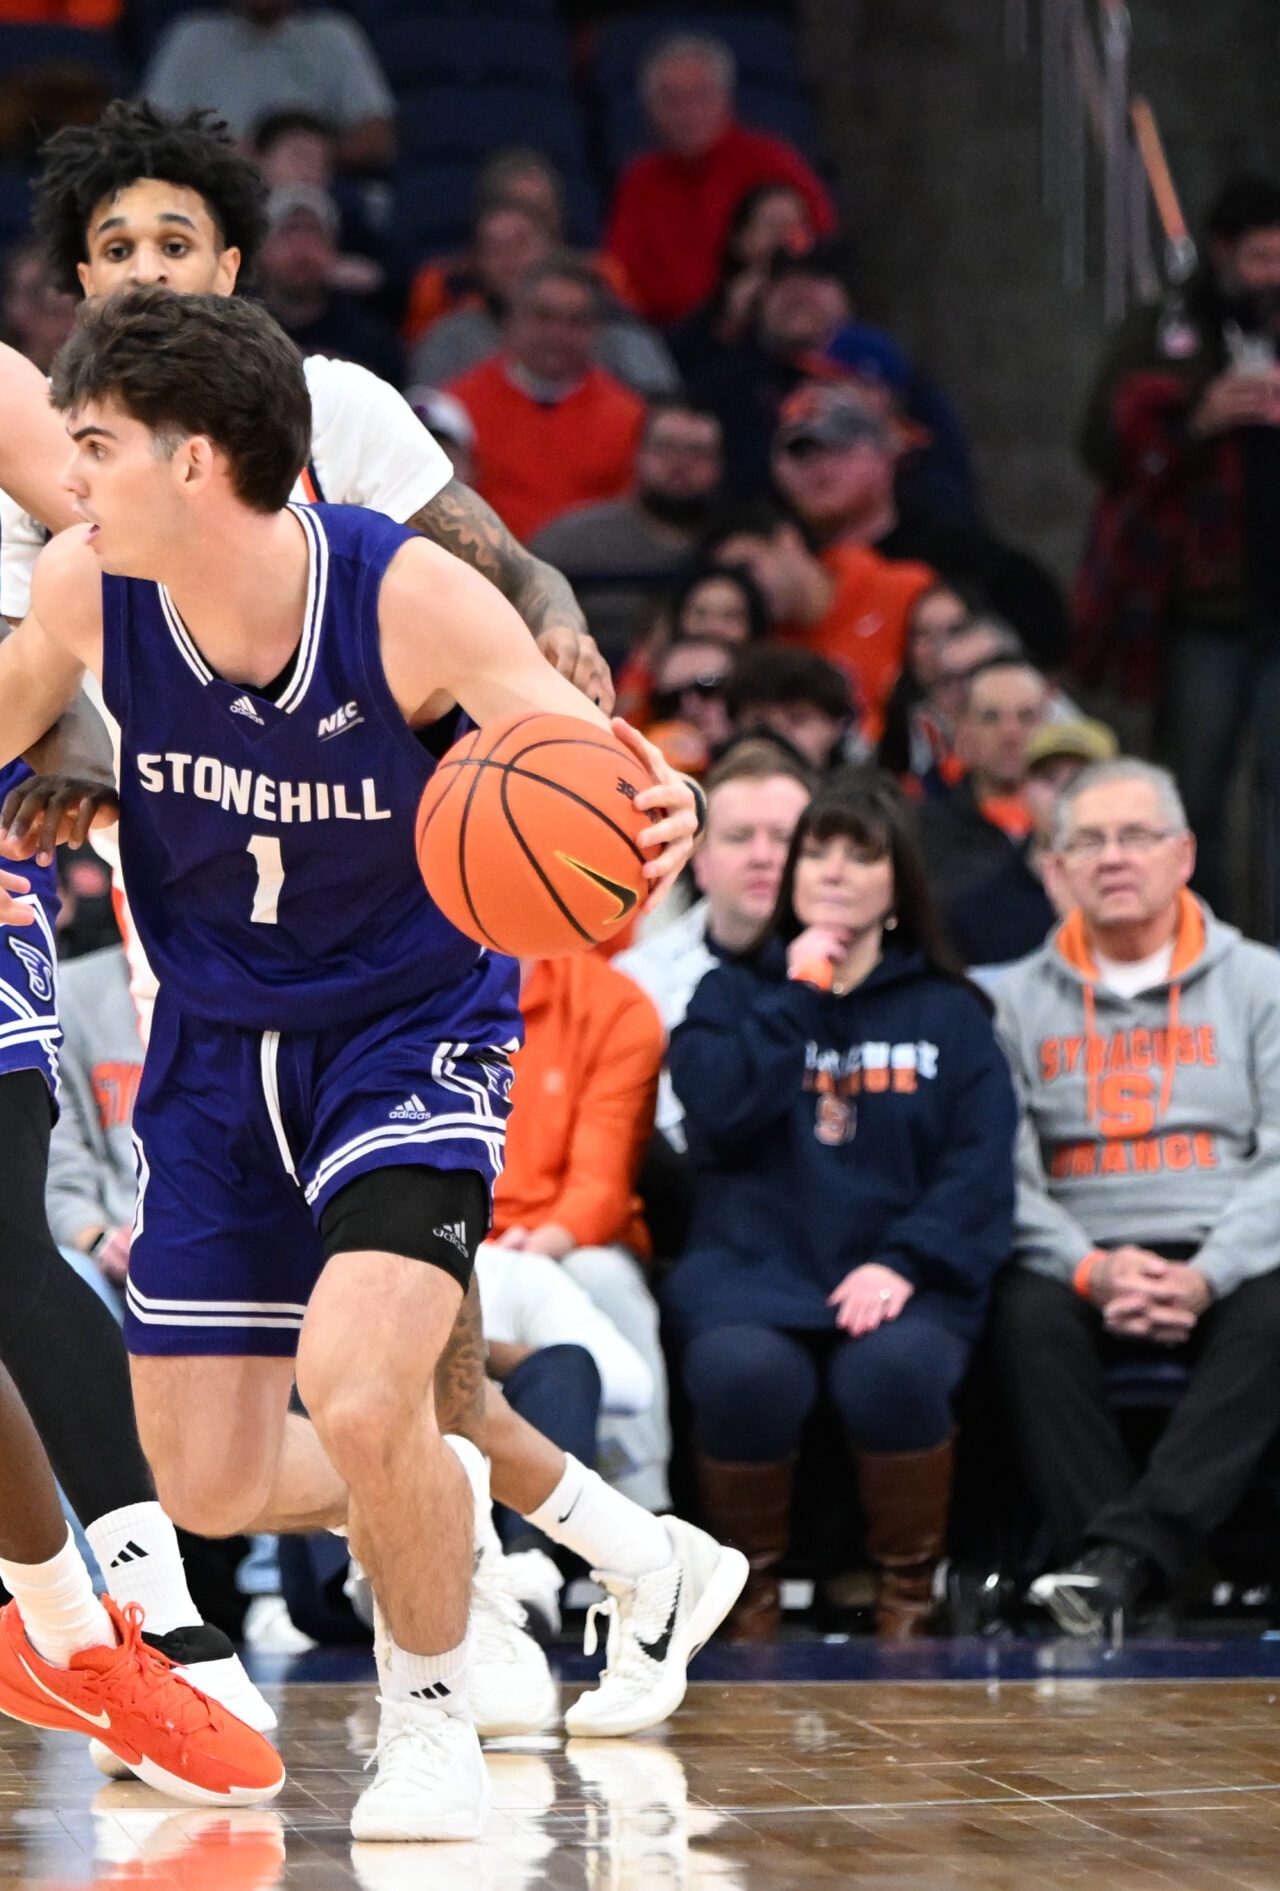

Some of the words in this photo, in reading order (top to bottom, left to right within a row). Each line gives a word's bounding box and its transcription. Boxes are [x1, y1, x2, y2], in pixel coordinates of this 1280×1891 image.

[229, 703, 265, 727] adidas
[317, 701, 359, 738] NEC
[137, 752, 392, 823] STONEHILL
[246, 834, 285, 925] 1
[1040, 1025, 1217, 1082] SYRACUSE
[389, 1110, 432, 1120] adidas
[1099, 1073, 1155, 1139] S
